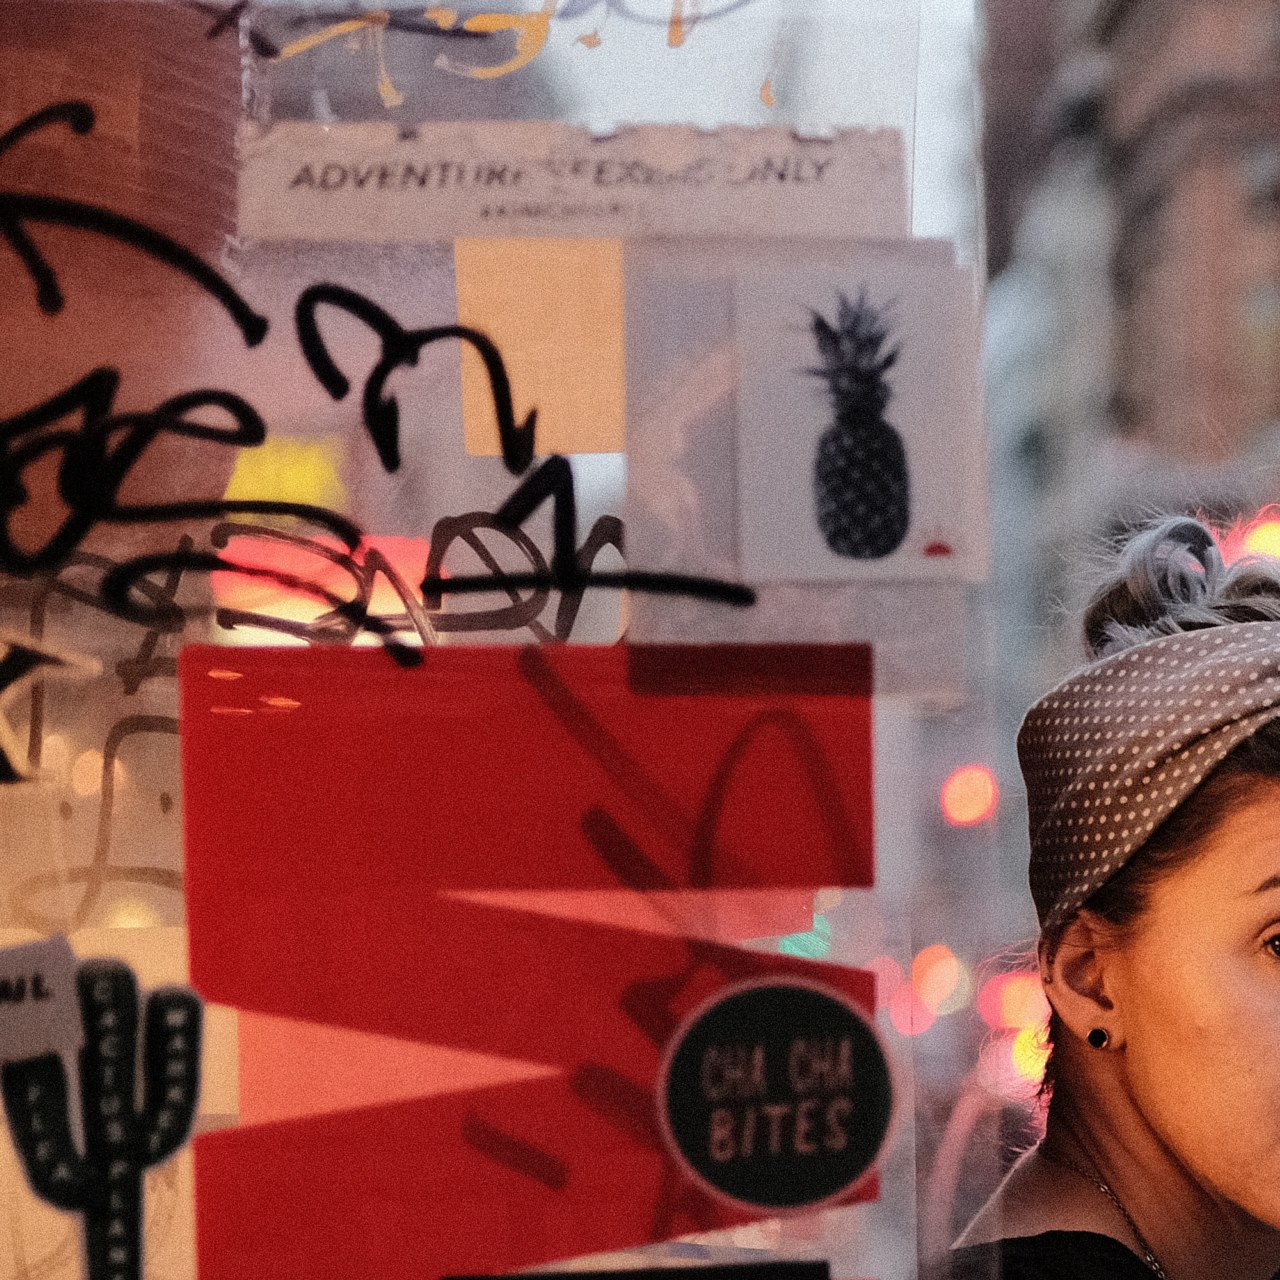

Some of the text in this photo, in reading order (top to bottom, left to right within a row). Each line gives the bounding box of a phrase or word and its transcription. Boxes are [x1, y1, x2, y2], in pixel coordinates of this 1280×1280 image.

[92, 978, 126, 1145] CACTUS
[700, 1036, 855, 1101] CHA CHA
[708, 1095, 855, 1163] BITES
